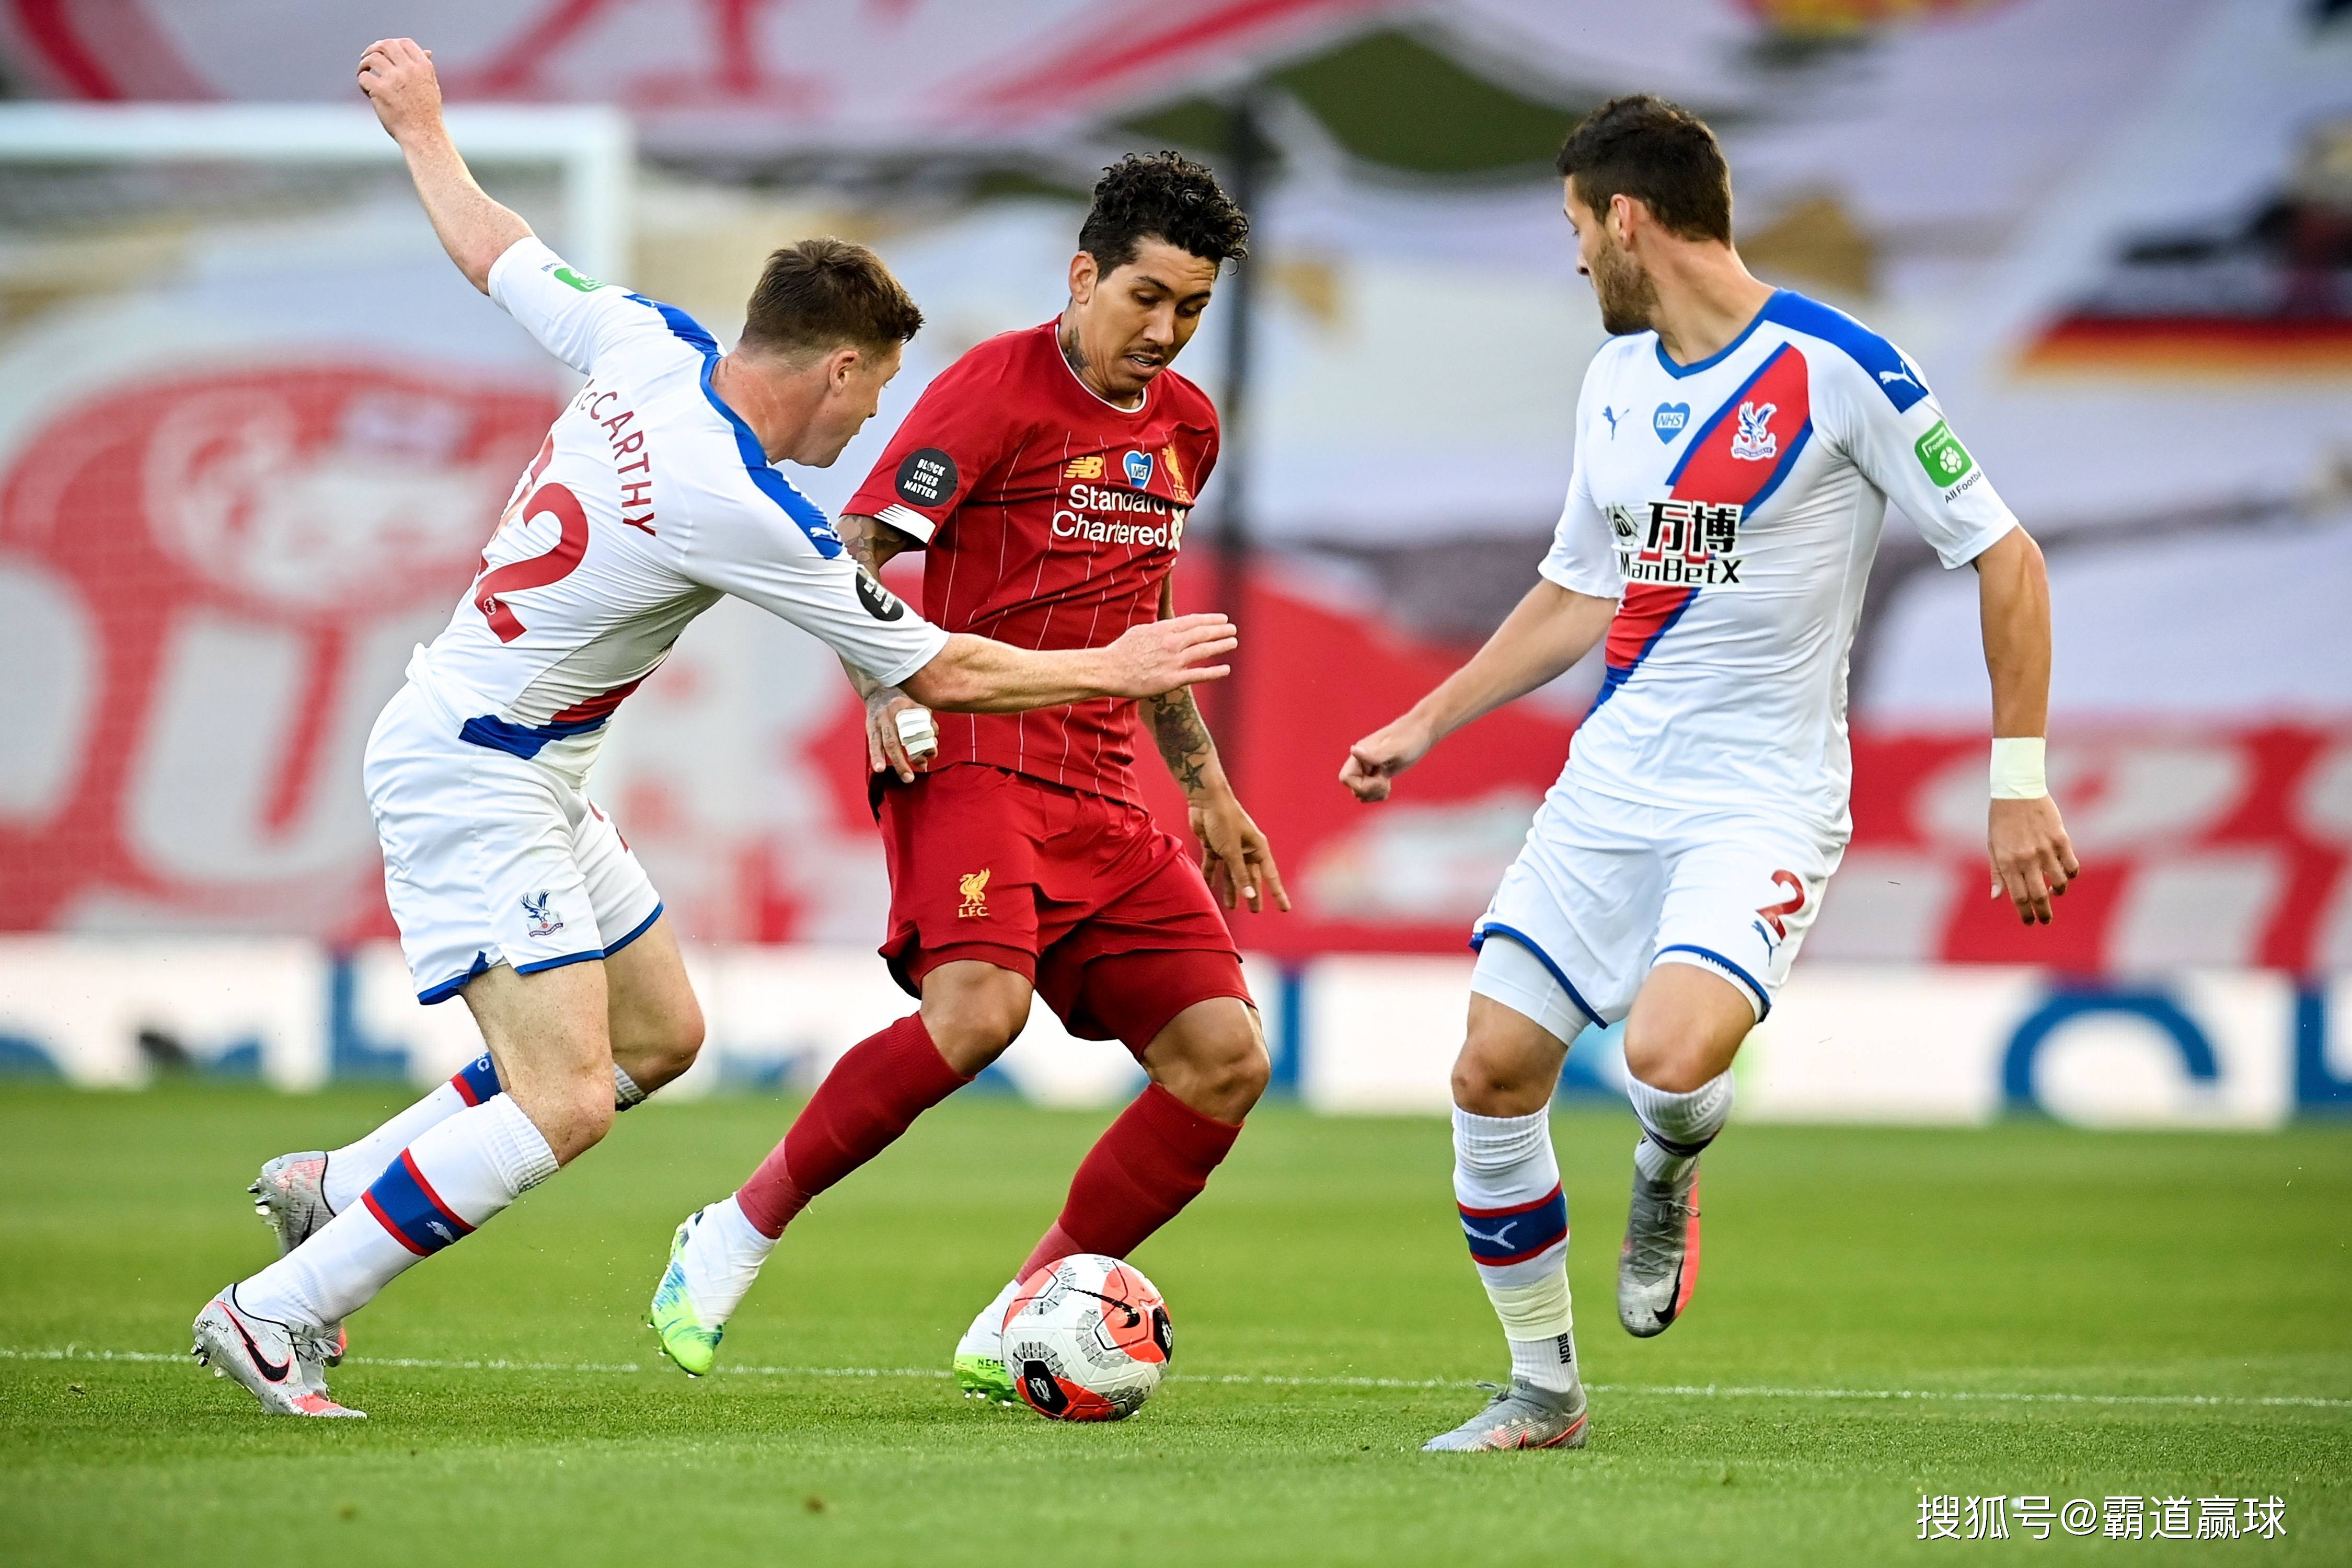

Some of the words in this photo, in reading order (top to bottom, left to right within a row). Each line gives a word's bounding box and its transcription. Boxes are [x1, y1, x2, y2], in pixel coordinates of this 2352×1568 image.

[1658, 414, 1681, 426] NHS
[903, 480, 938, 500] MATTER
[913, 470, 939, 487] LIVES
[1945, 490, 1958, 504] All
[1955, 471, 1982, 494] Footb
[1068, 484, 1166, 516] Standard
[1052, 510, 1168, 547] Chartered
[1647, 502, 1737, 553] 万博
[1620, 551, 1743, 584] ManBetX
[1755, 869, 1805, 941] 2
